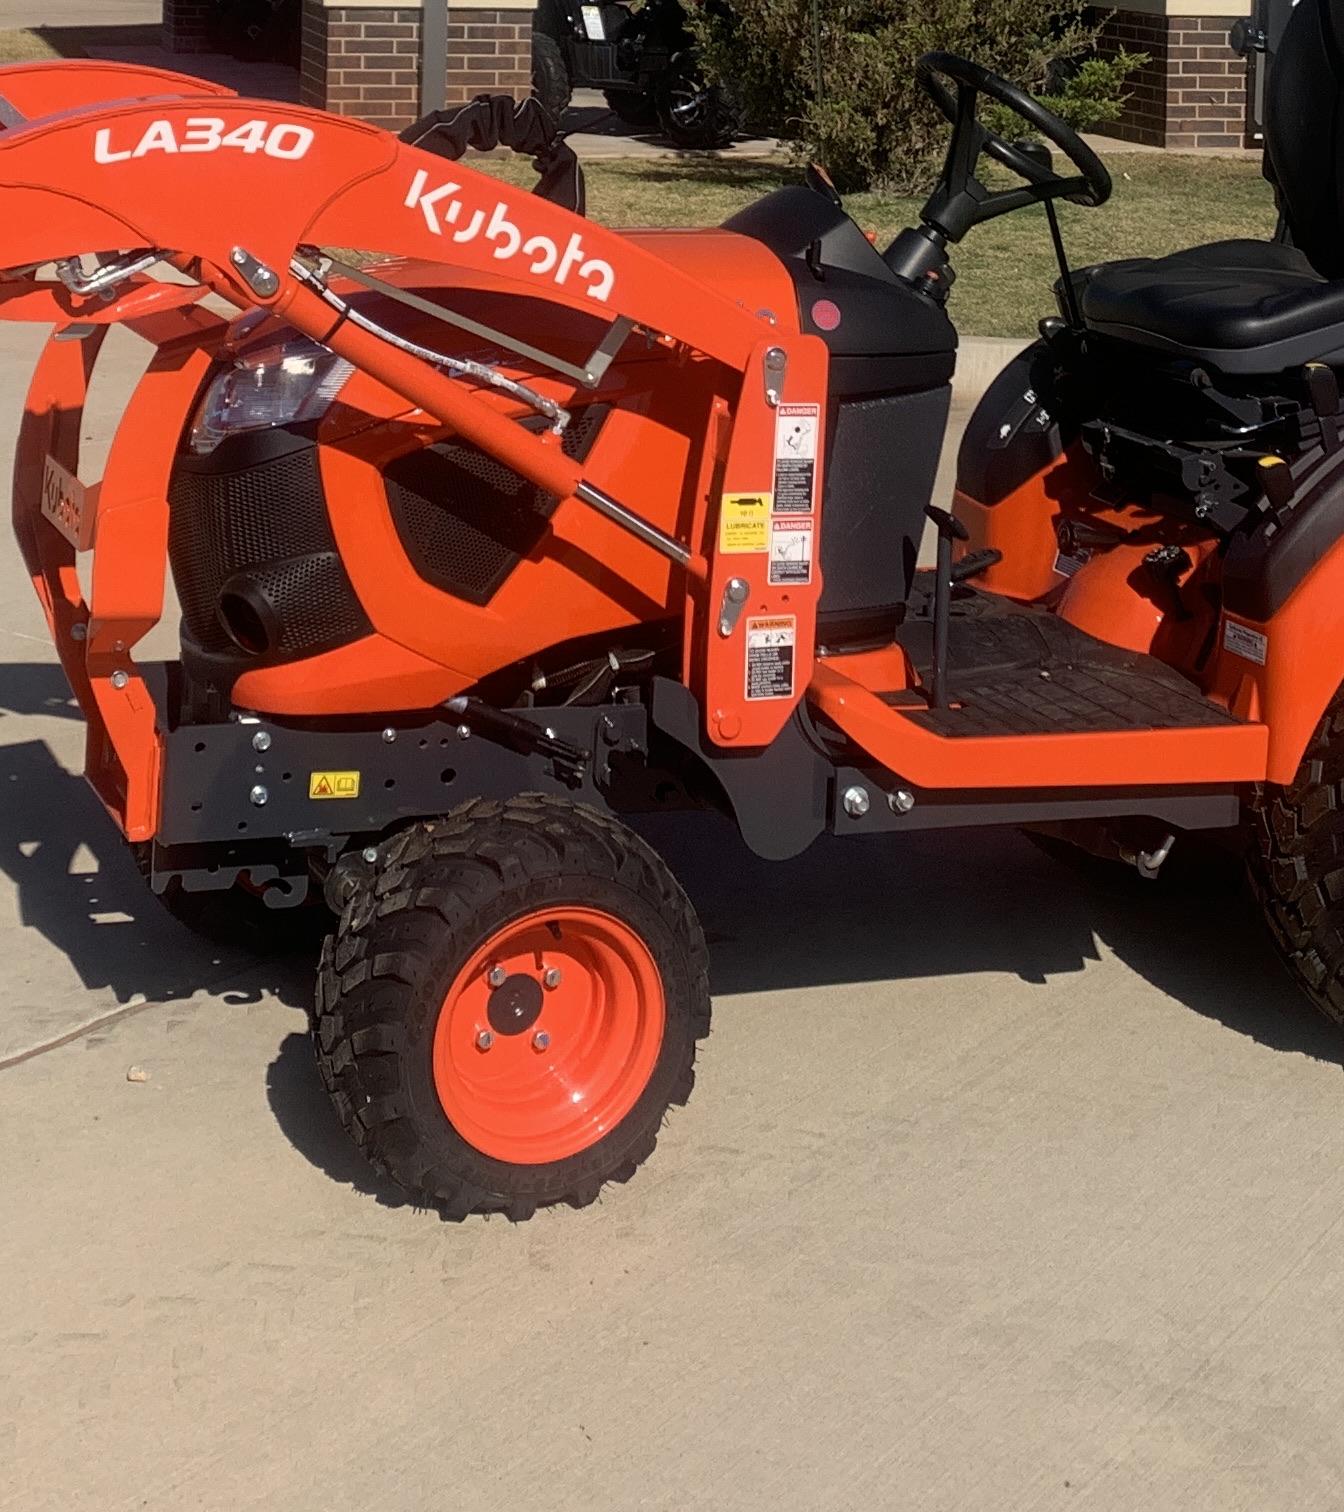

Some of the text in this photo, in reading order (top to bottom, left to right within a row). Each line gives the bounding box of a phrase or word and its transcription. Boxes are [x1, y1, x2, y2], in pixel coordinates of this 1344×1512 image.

[94, 117, 315, 164] LA340
[404, 169, 616, 302] Kubota
[786, 406, 817, 416] DANGER
[726, 522, 765, 530] LUBRICATE
[781, 521, 811, 530] DANGER
